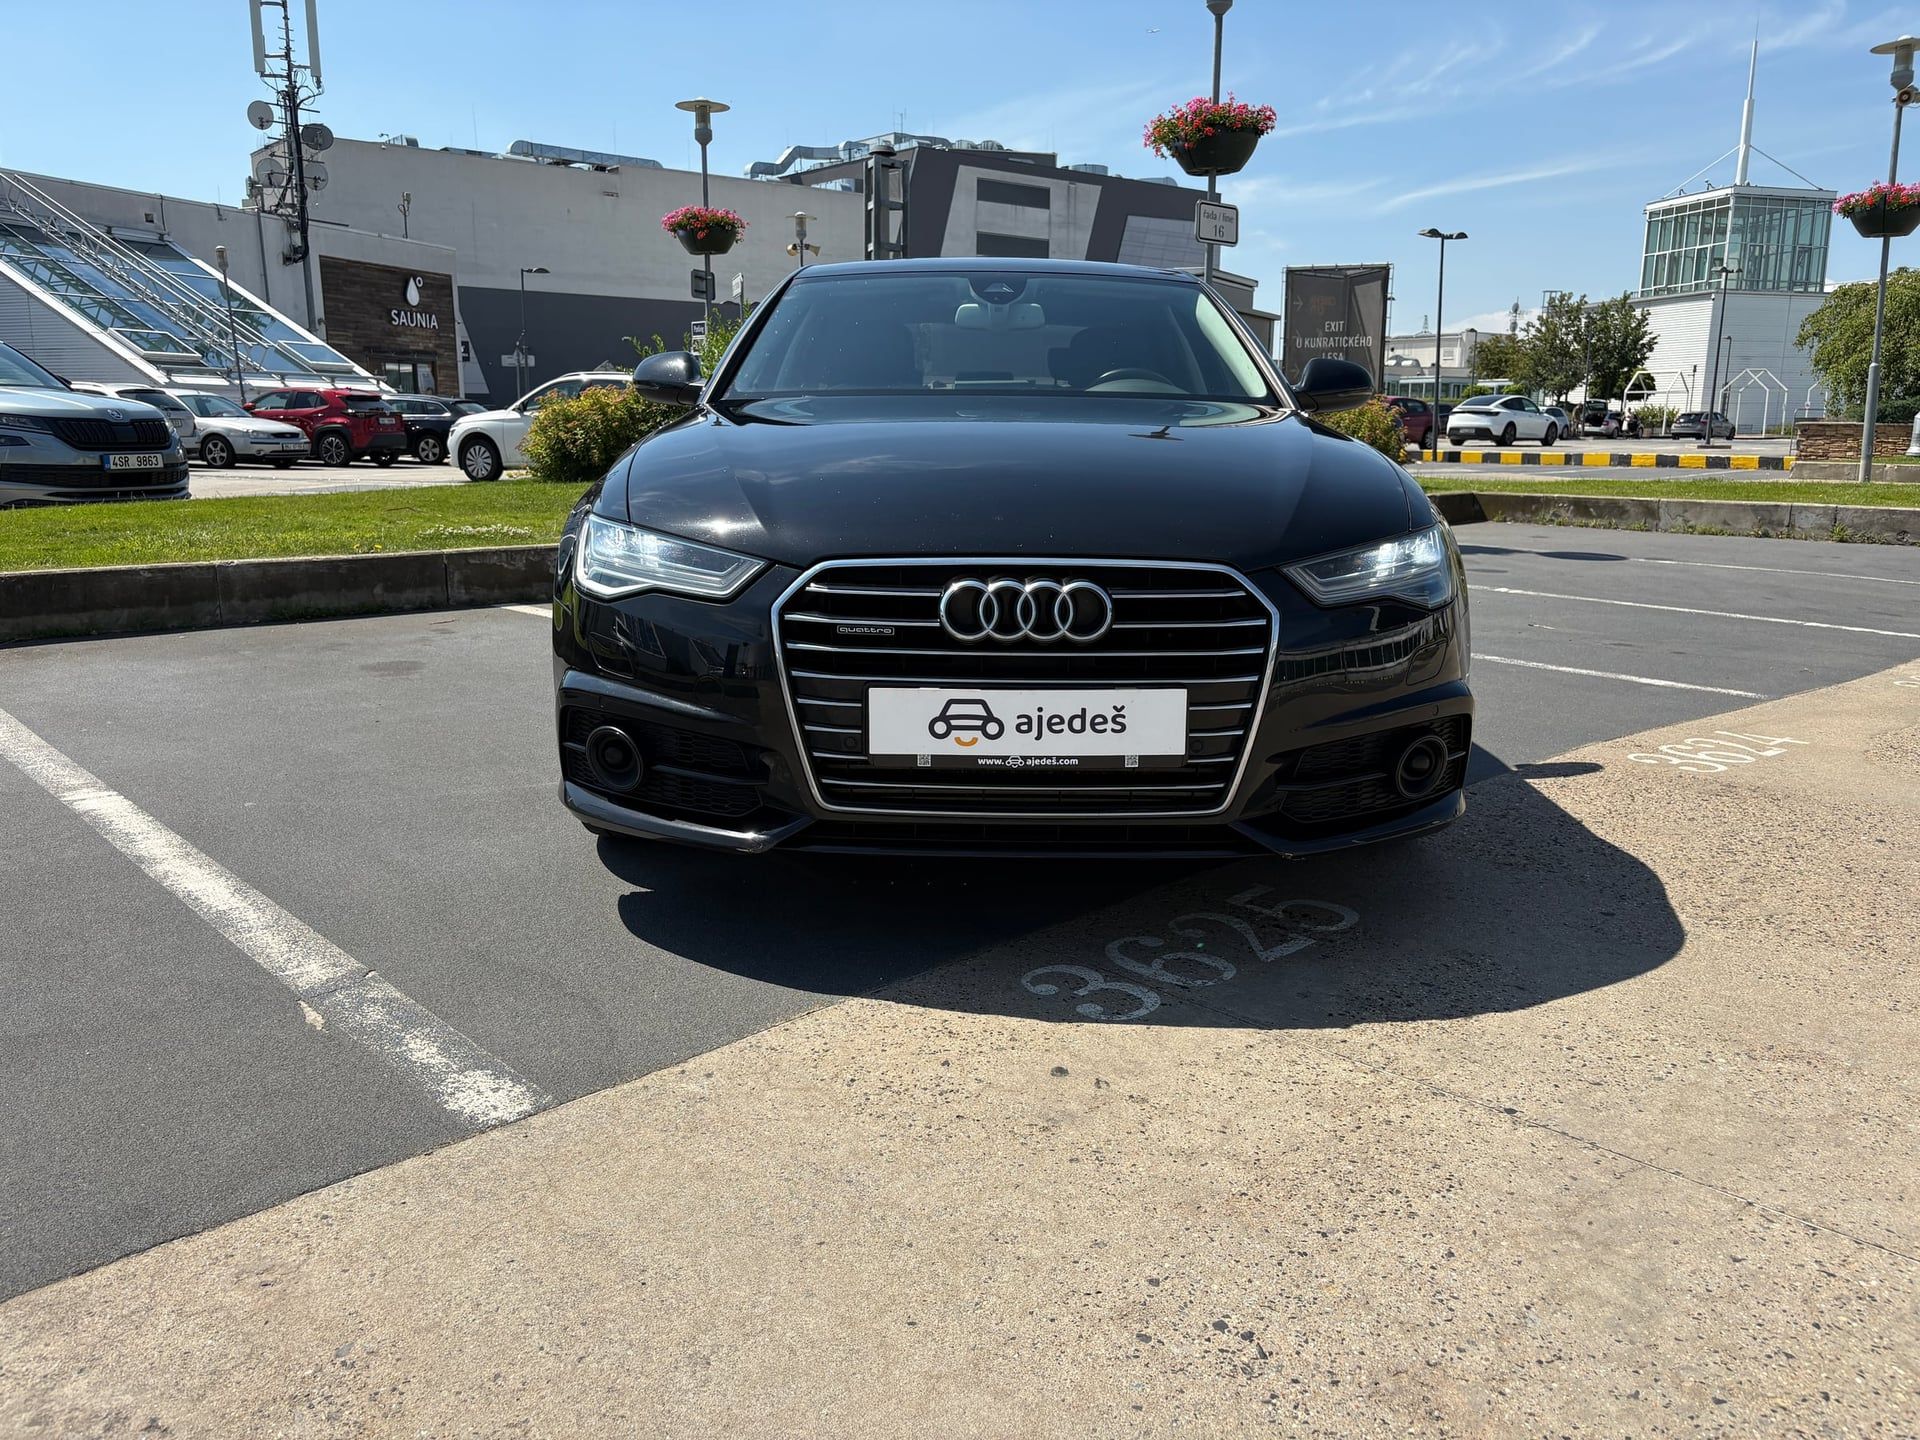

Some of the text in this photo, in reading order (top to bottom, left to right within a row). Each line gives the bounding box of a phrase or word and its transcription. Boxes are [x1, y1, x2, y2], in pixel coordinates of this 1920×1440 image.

[1213, 224, 1225, 239] 16
[391, 309, 438, 329] SAUNIA
[1325, 321, 1344, 332] EXIT
[1296, 334, 1372, 349] U KUNRATICKÉHO
[113, 456, 159, 467] 4SR 9863
[1015, 705, 1127, 741] ajedeš
[1627, 730, 1811, 773] 3624
[978, 756, 1079, 766] www. ajedeš.com
[1021, 885, 1361, 1021] 3625
